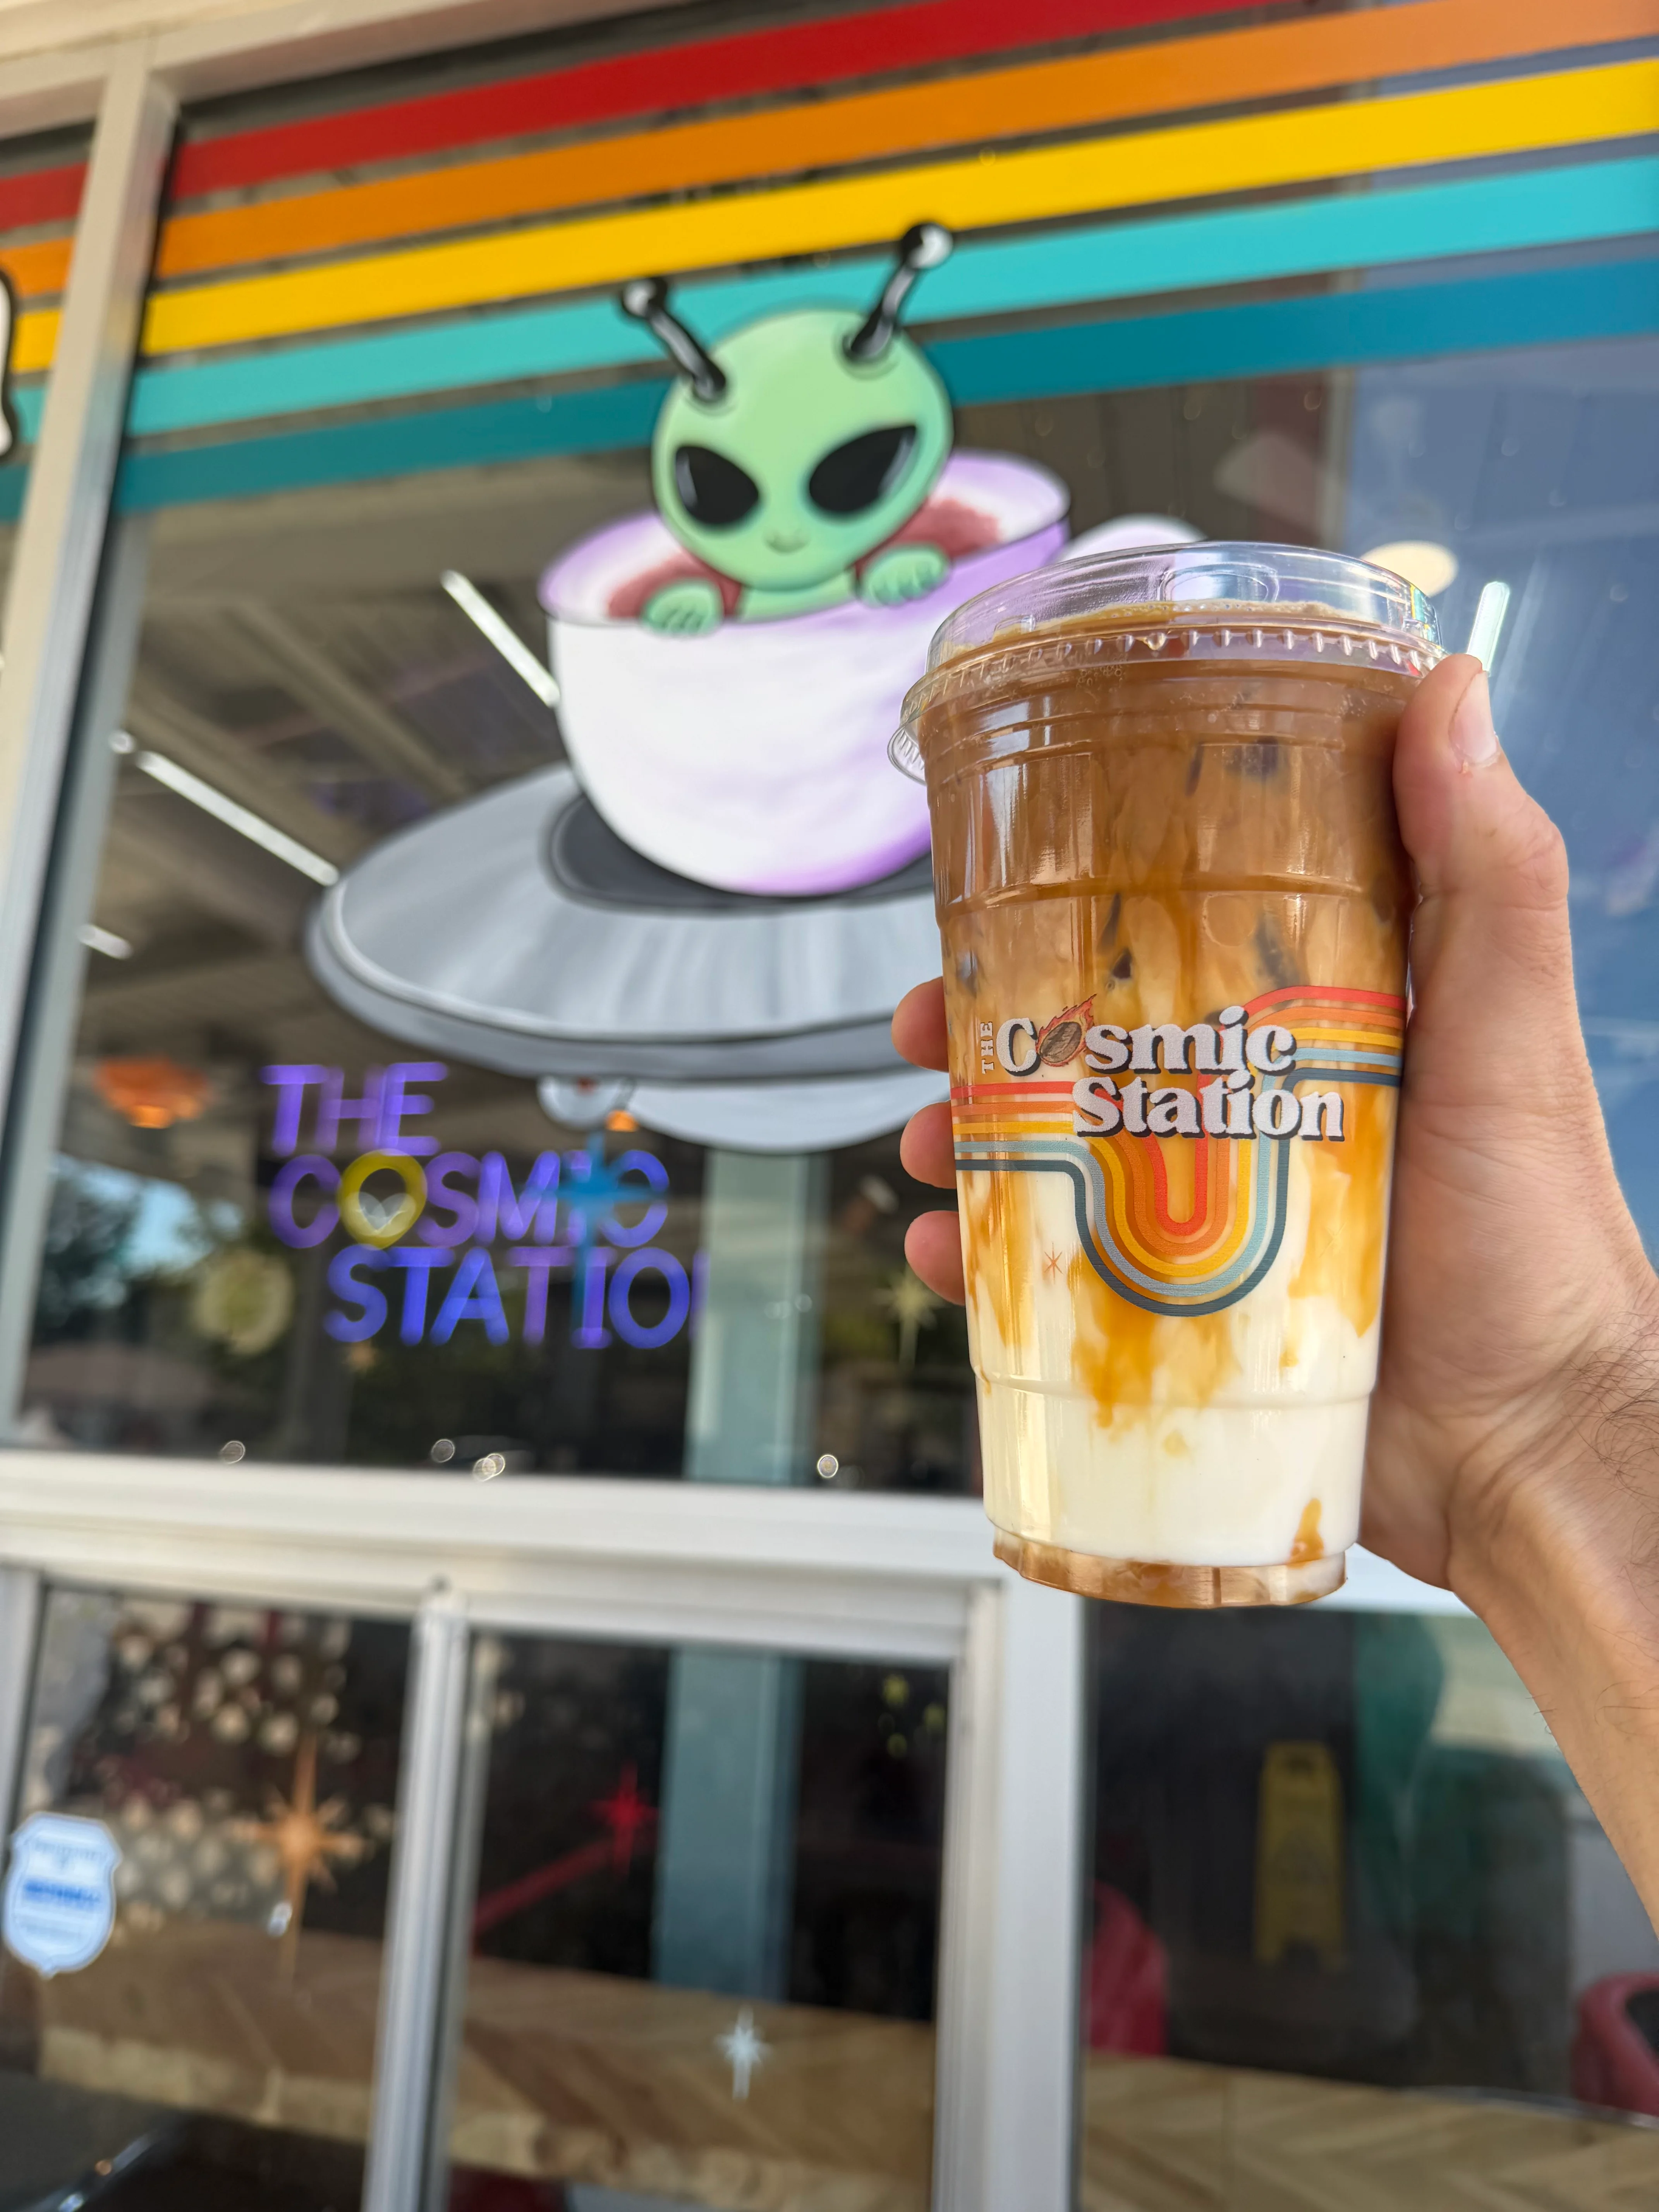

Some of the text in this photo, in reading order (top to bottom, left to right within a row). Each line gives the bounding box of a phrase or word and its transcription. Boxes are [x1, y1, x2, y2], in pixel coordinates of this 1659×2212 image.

[980, 1021, 994, 1074] THE
[260, 1061, 448, 1156] THE
[1072, 1070, 1344, 1141] Station
[323, 1244, 709, 1349] STATIO
